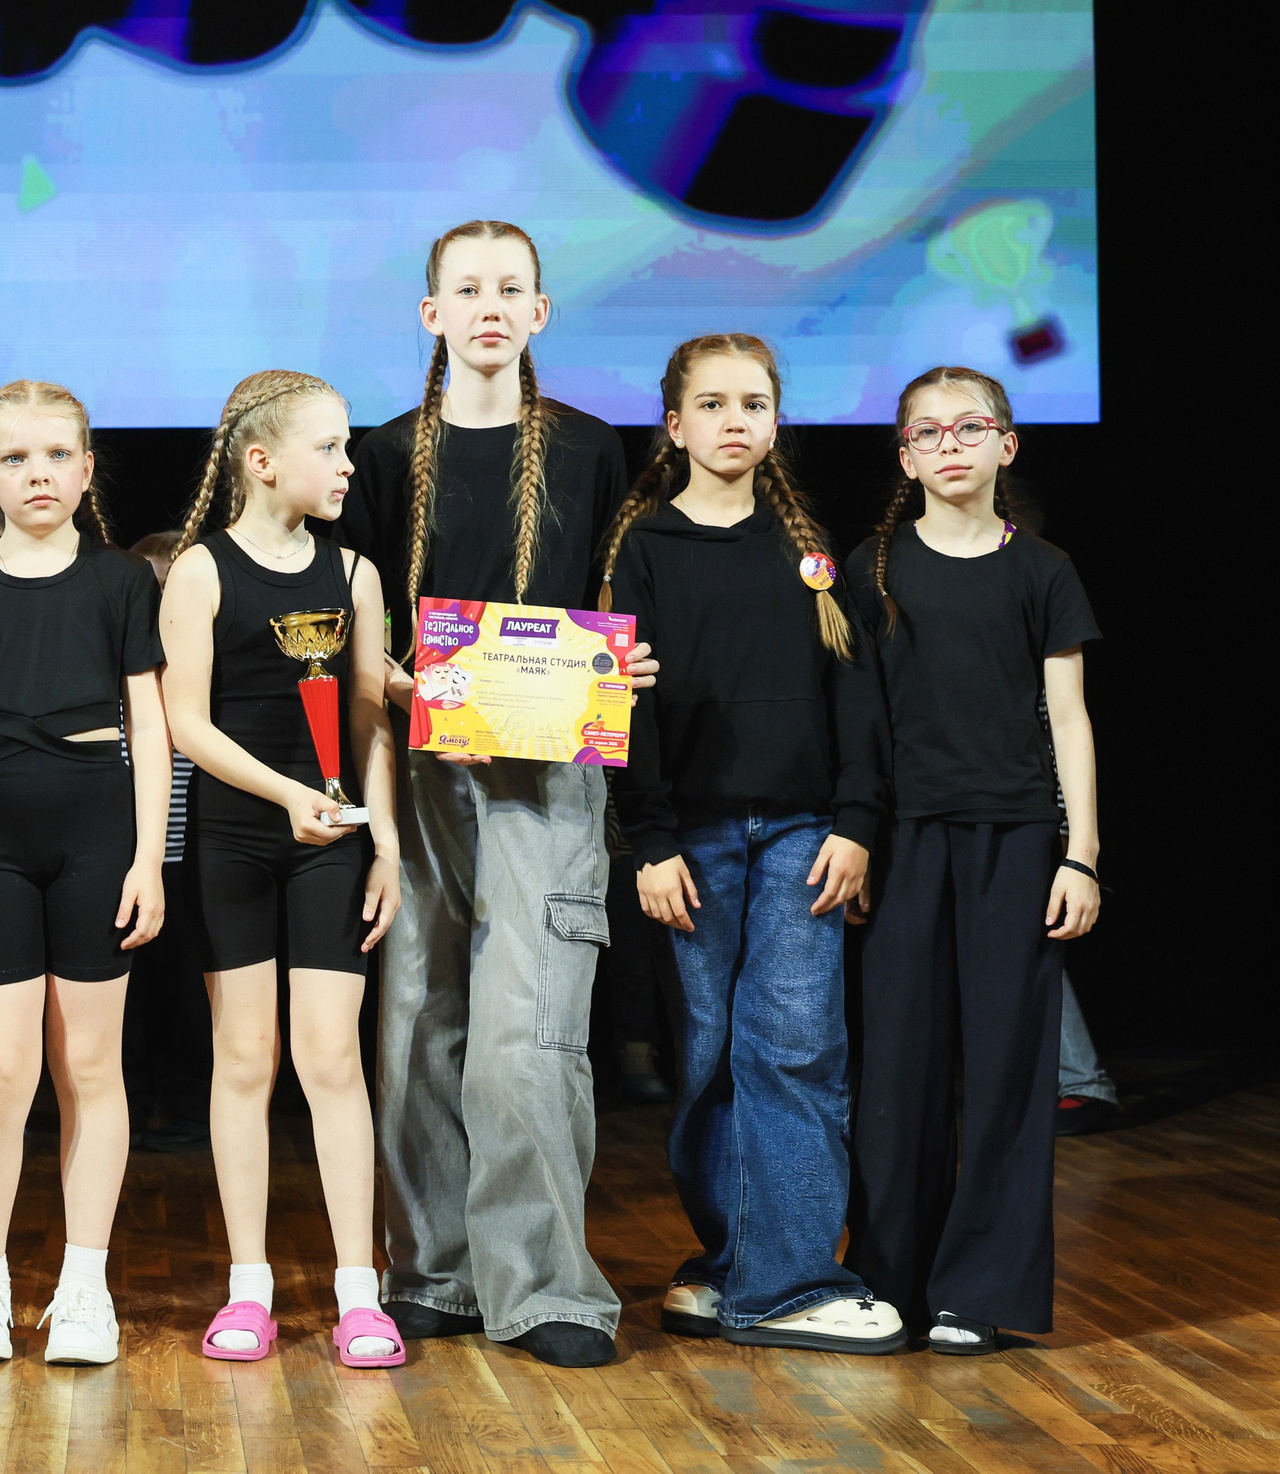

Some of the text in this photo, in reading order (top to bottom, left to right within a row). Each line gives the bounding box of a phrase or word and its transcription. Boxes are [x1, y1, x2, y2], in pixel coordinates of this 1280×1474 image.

[506, 620, 552, 634] ЛАУРЕАТ
[482, 652, 547, 665] ТЕАТРАЛЬНАЯ
[550, 657, 587, 669] СТУДИЯ
